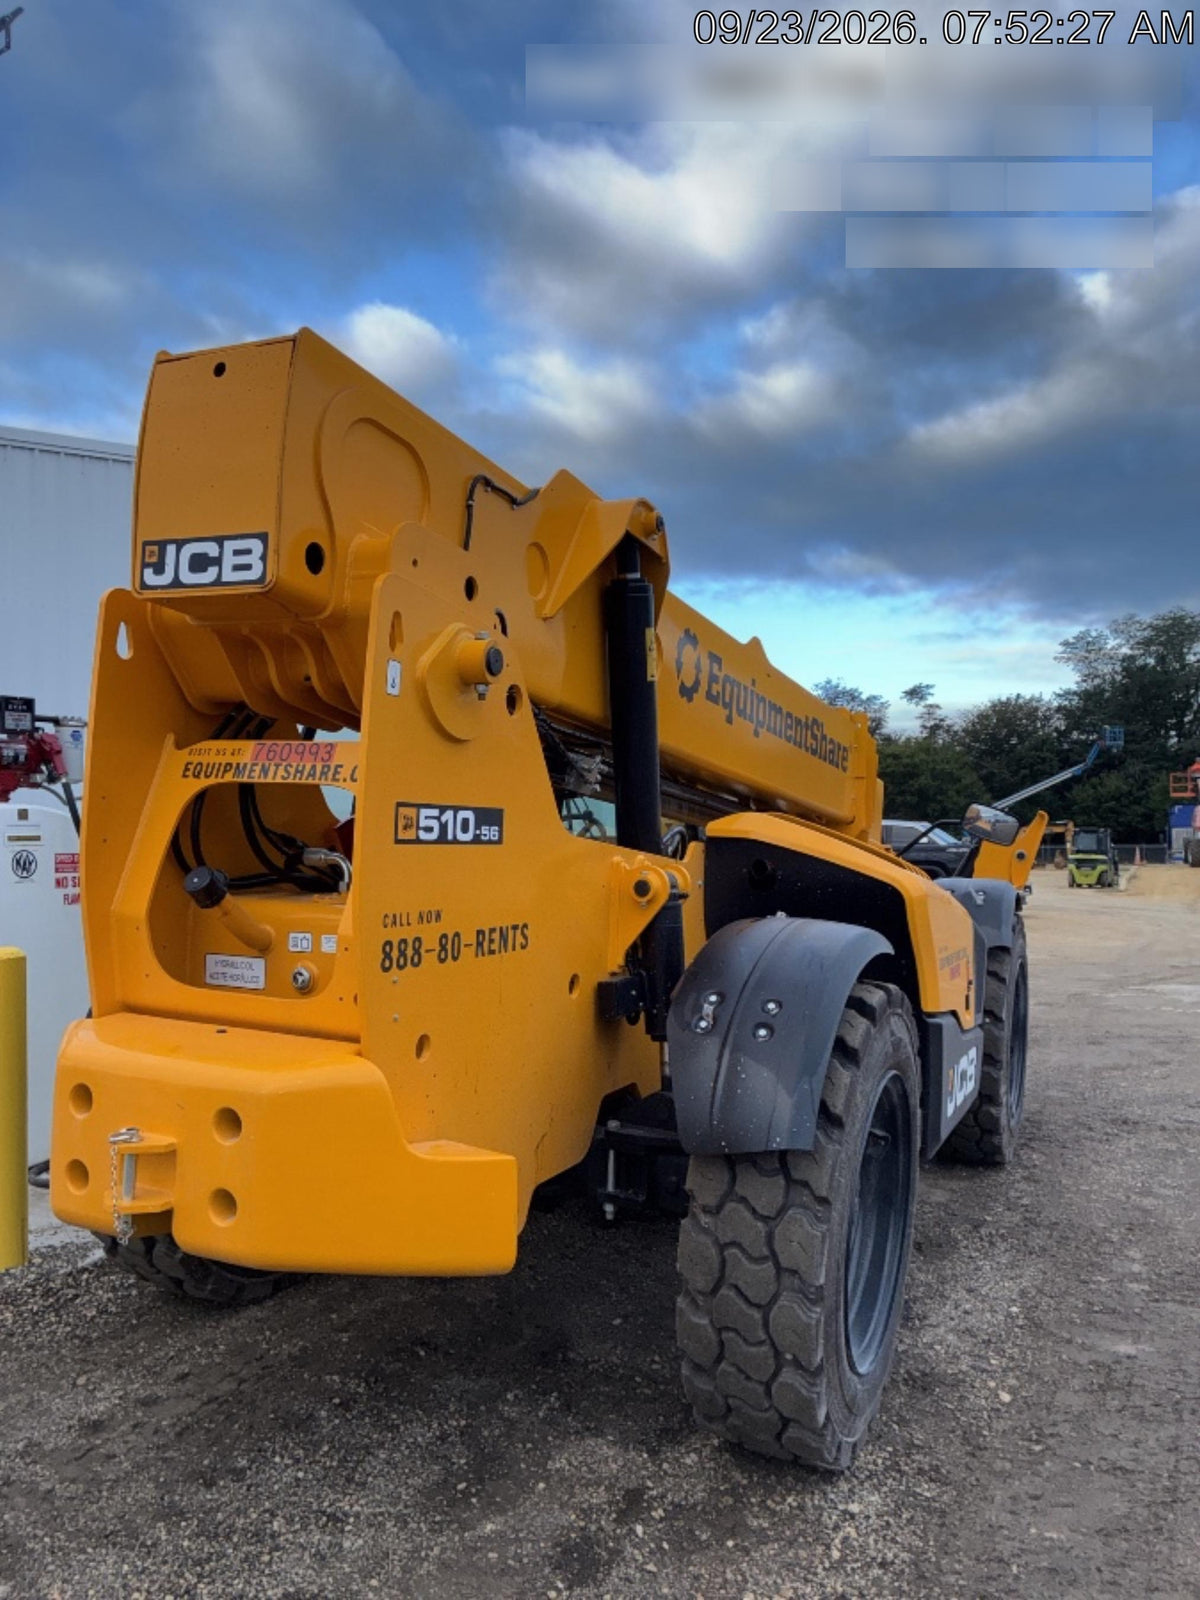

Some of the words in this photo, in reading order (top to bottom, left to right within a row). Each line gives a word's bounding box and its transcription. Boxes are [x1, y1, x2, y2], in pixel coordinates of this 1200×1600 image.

[143, 538, 264, 586] JCB
[706, 650, 849, 773] EquipmentShare
[253, 742, 337, 763] 760993
[417, 807, 499, 842] 510-56
[383, 913, 412, 928] CALL
[417, 910, 443, 925] NOW
[380, 922, 530, 973] 888-80-RENTS
[946, 1046, 977, 1118] JCB
